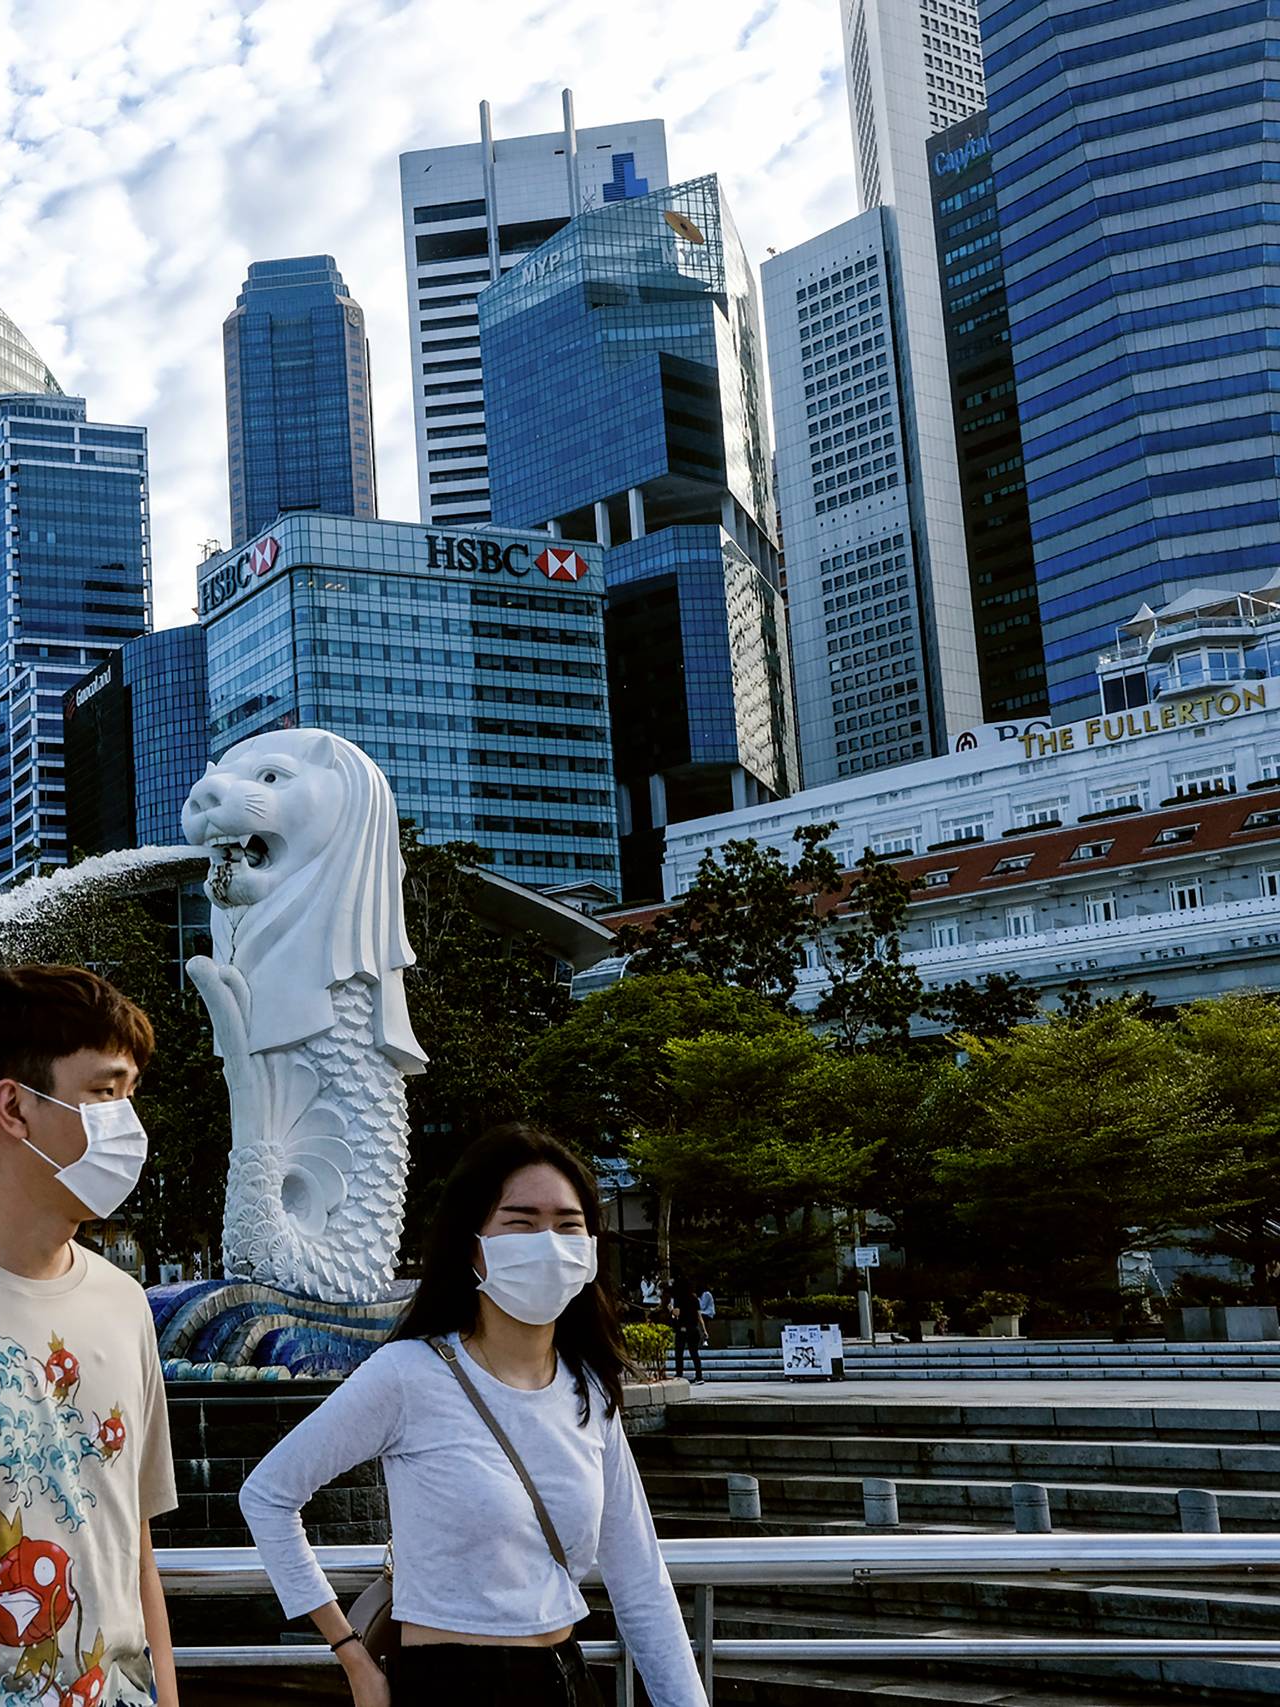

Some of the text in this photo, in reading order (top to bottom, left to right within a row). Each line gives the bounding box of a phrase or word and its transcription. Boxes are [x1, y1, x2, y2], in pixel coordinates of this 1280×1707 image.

[521, 252, 562, 285] MYP
[662, 242, 709, 267] MYP
[425, 534, 531, 578] HSBC
[199, 551, 253, 616] HSBC
[1019, 727, 1073, 759] THE
[1086, 684, 1266, 745] FULLERTON
